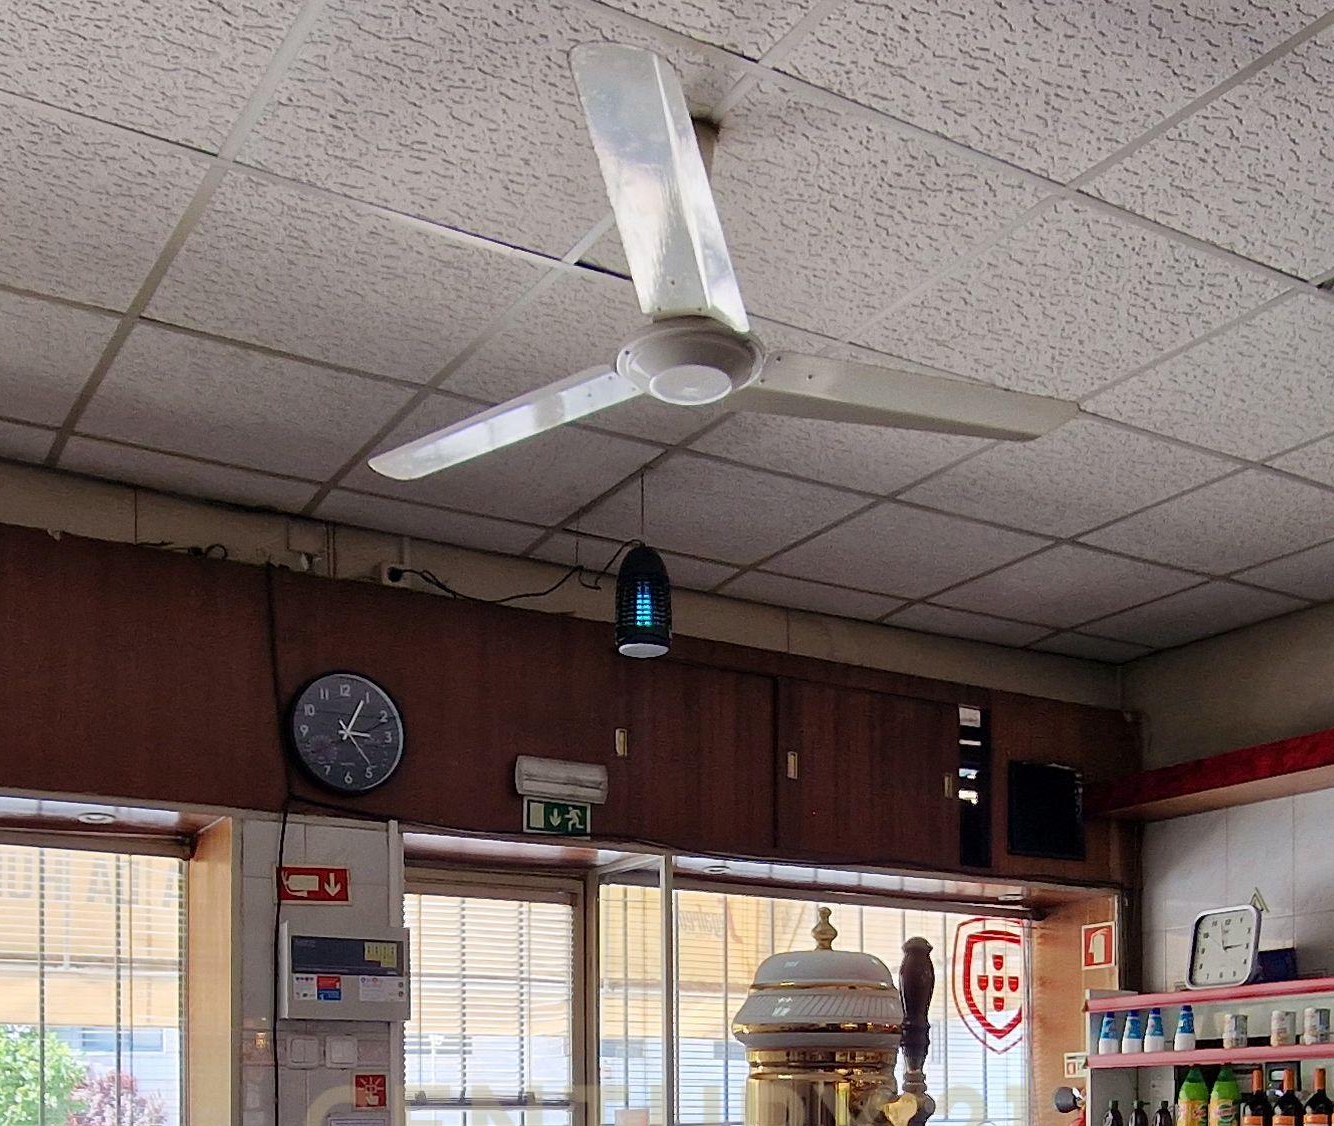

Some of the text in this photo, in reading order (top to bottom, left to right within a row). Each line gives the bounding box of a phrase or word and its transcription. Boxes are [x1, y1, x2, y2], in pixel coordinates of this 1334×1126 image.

[319, 688, 330, 700] 11
[339, 684, 351, 697] 12
[304, 704, 315, 716] 10
[379, 710, 388, 723] 2
[299, 725, 309, 736] 9
[385, 731, 393, 743] 3
[344, 772, 353, 784] 6
